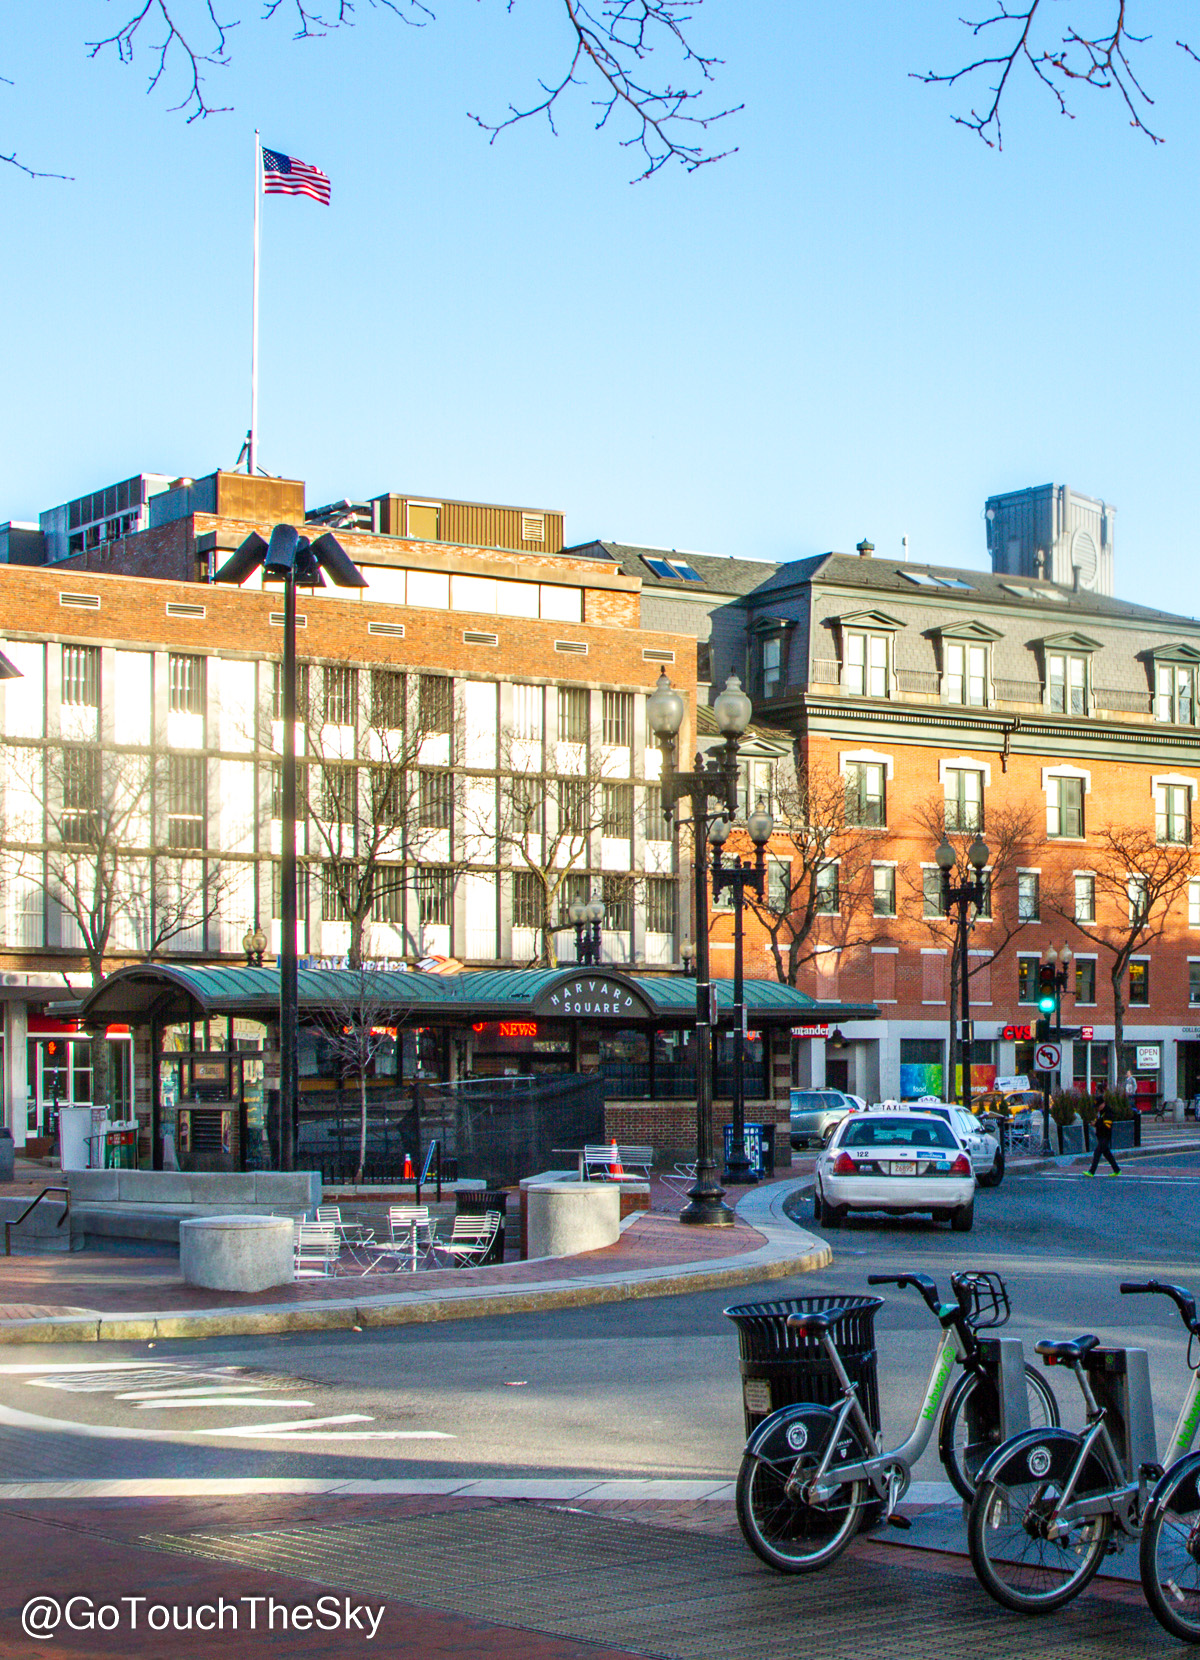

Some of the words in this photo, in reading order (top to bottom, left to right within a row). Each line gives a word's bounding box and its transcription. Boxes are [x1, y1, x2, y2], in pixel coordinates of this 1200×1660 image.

[340, 957, 408, 972] Aerica
[551, 982, 633, 1007] HARVARD
[564, 1002, 620, 1013] SQUARE
[500, 1022, 537, 1037] NEWS
[1003, 1025, 1031, 1040] CVS
[922, 1363, 950, 1420] Hubway
